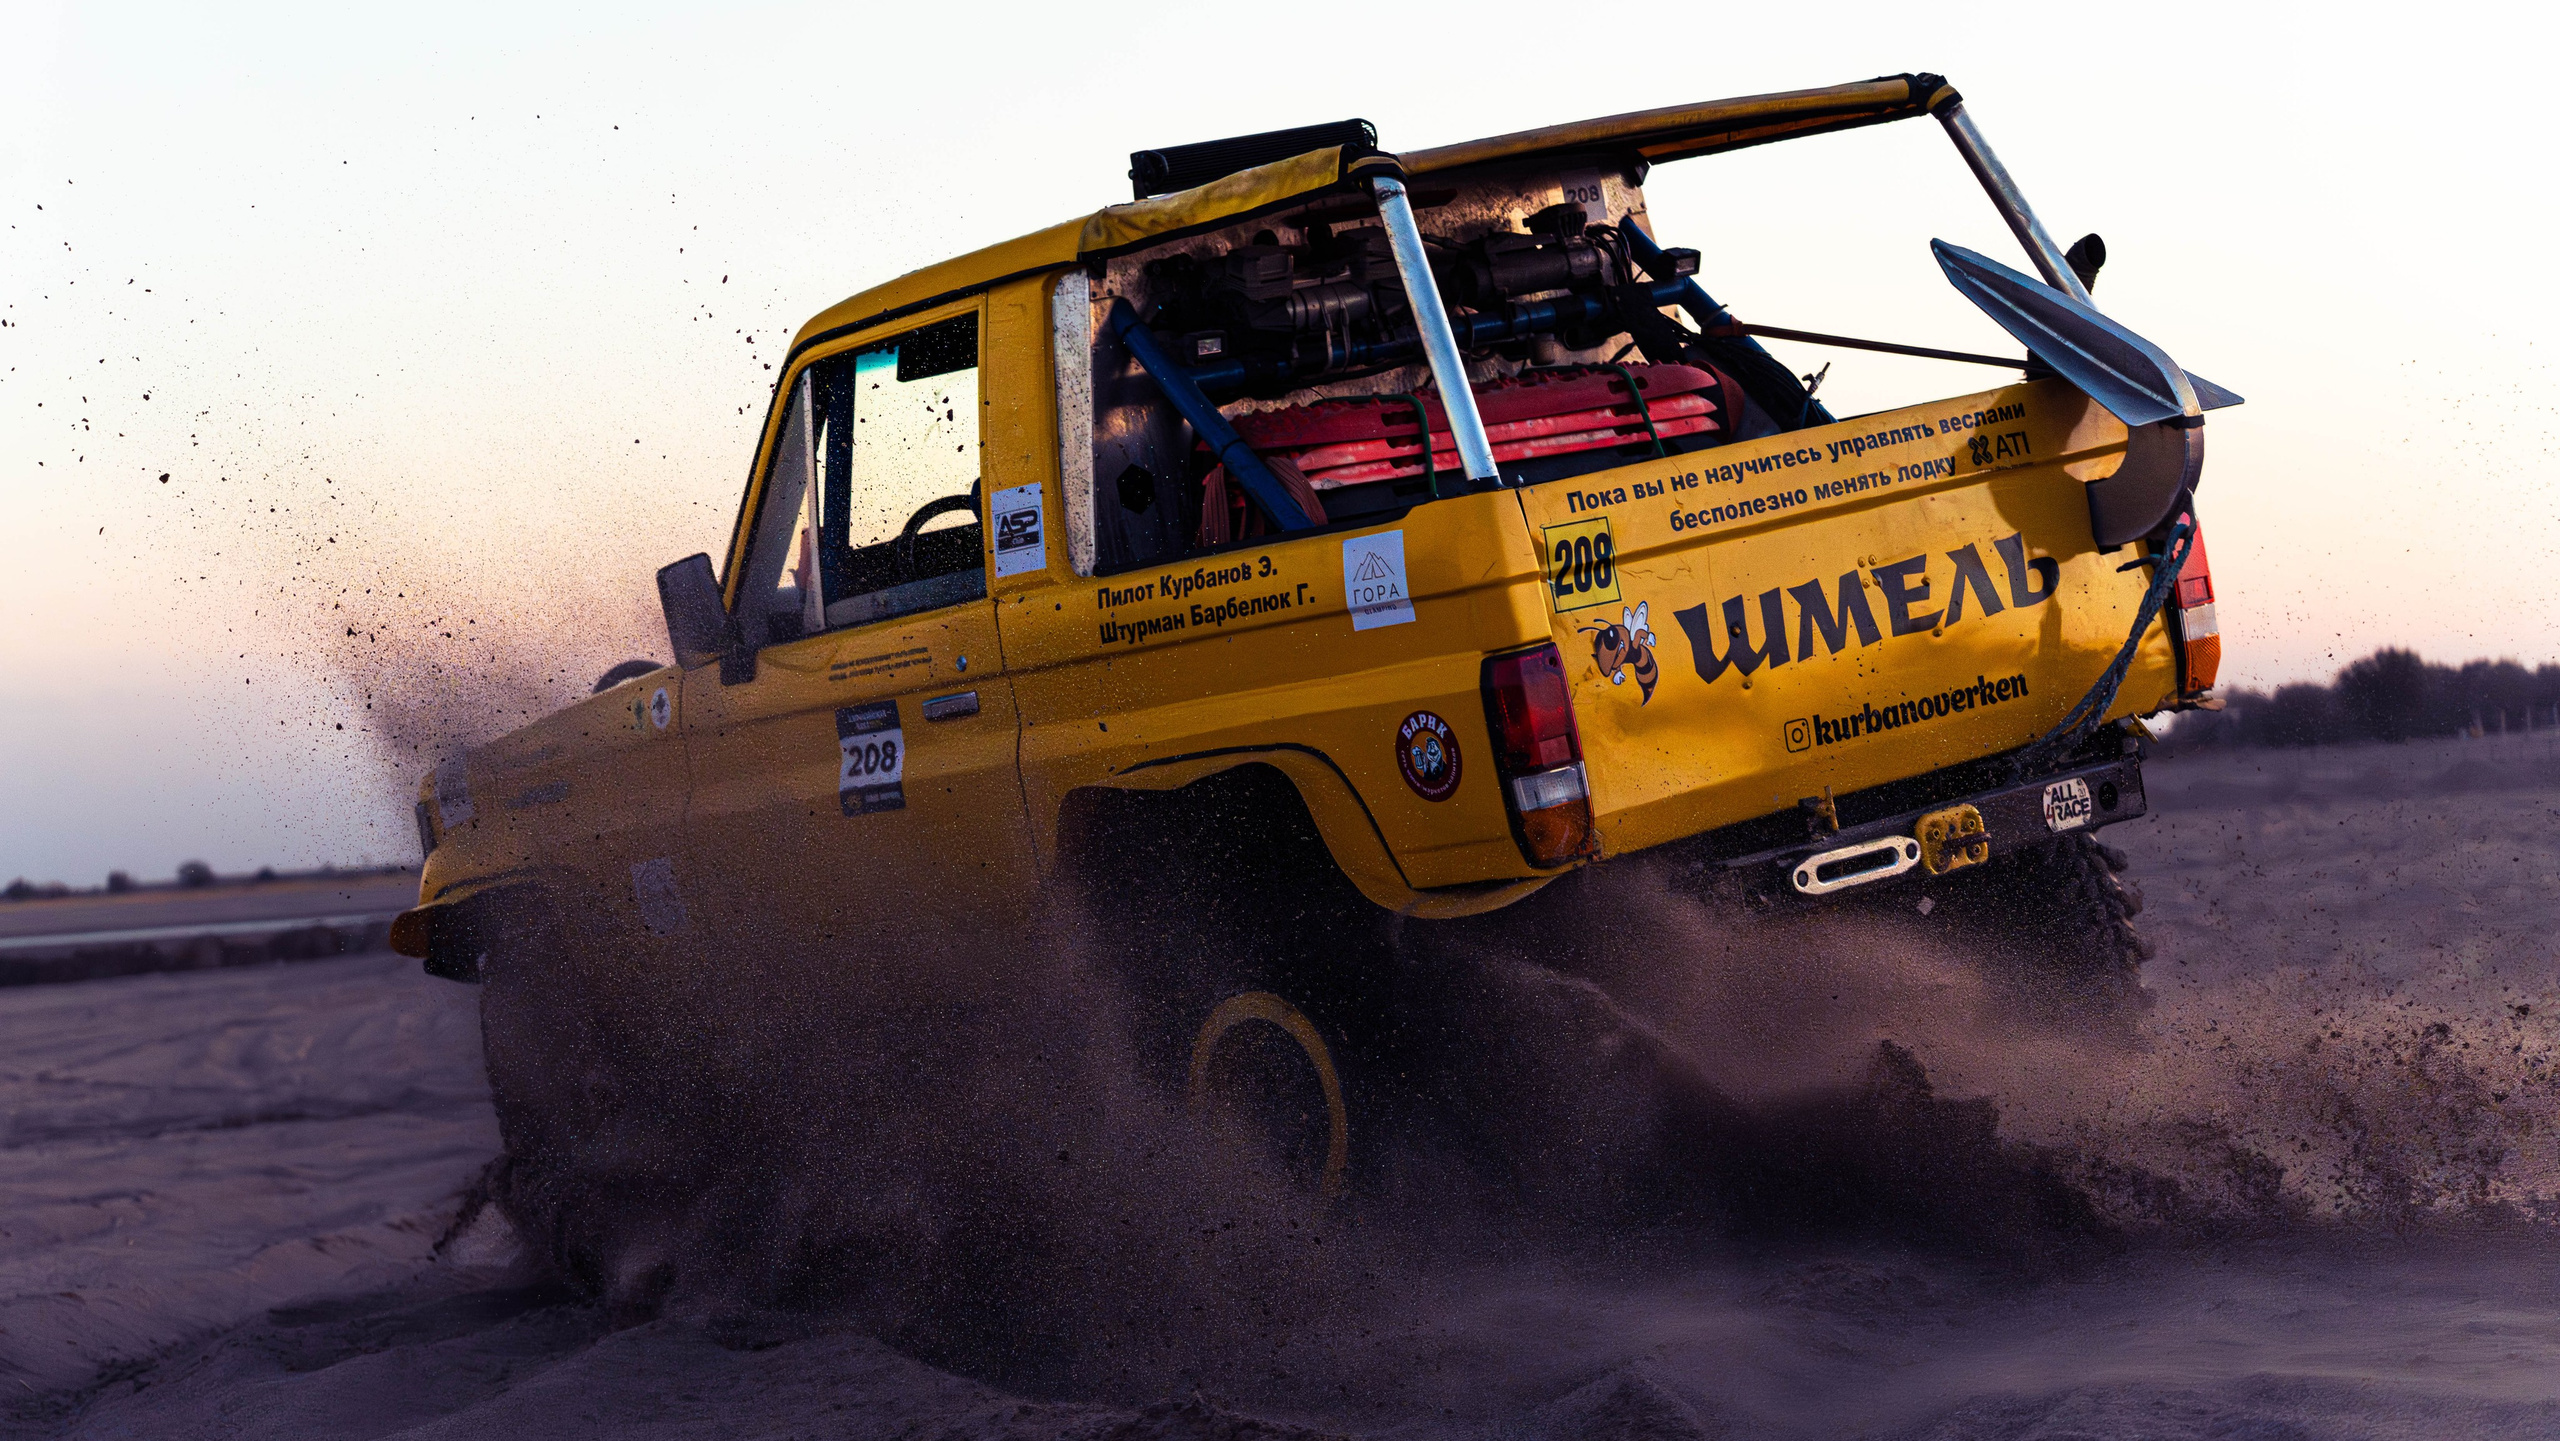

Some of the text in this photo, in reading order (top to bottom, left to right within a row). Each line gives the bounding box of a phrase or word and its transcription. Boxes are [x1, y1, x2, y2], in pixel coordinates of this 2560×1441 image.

[1567, 185, 1600, 203] 208
[1567, 402, 2026, 513] Пока вы не научитесь управлять веслами
[1669, 455, 1956, 532] бесполезно менять лодку
[1097, 556, 1278, 610] Пилот Курбанов Э.
[1353, 583, 1400, 605] ГОРА
[1554, 532, 1613, 598] 208
[1099, 583, 1315, 645] Штурман Барбелюк Г.
[1673, 532, 2061, 684] ШМЕЛЬ
[1401, 713, 1448, 740] БАРИК
[1814, 672, 2030, 747] kurbanoverken
[848, 741, 897, 777] 208
[2051, 783, 2077, 805] ALL
